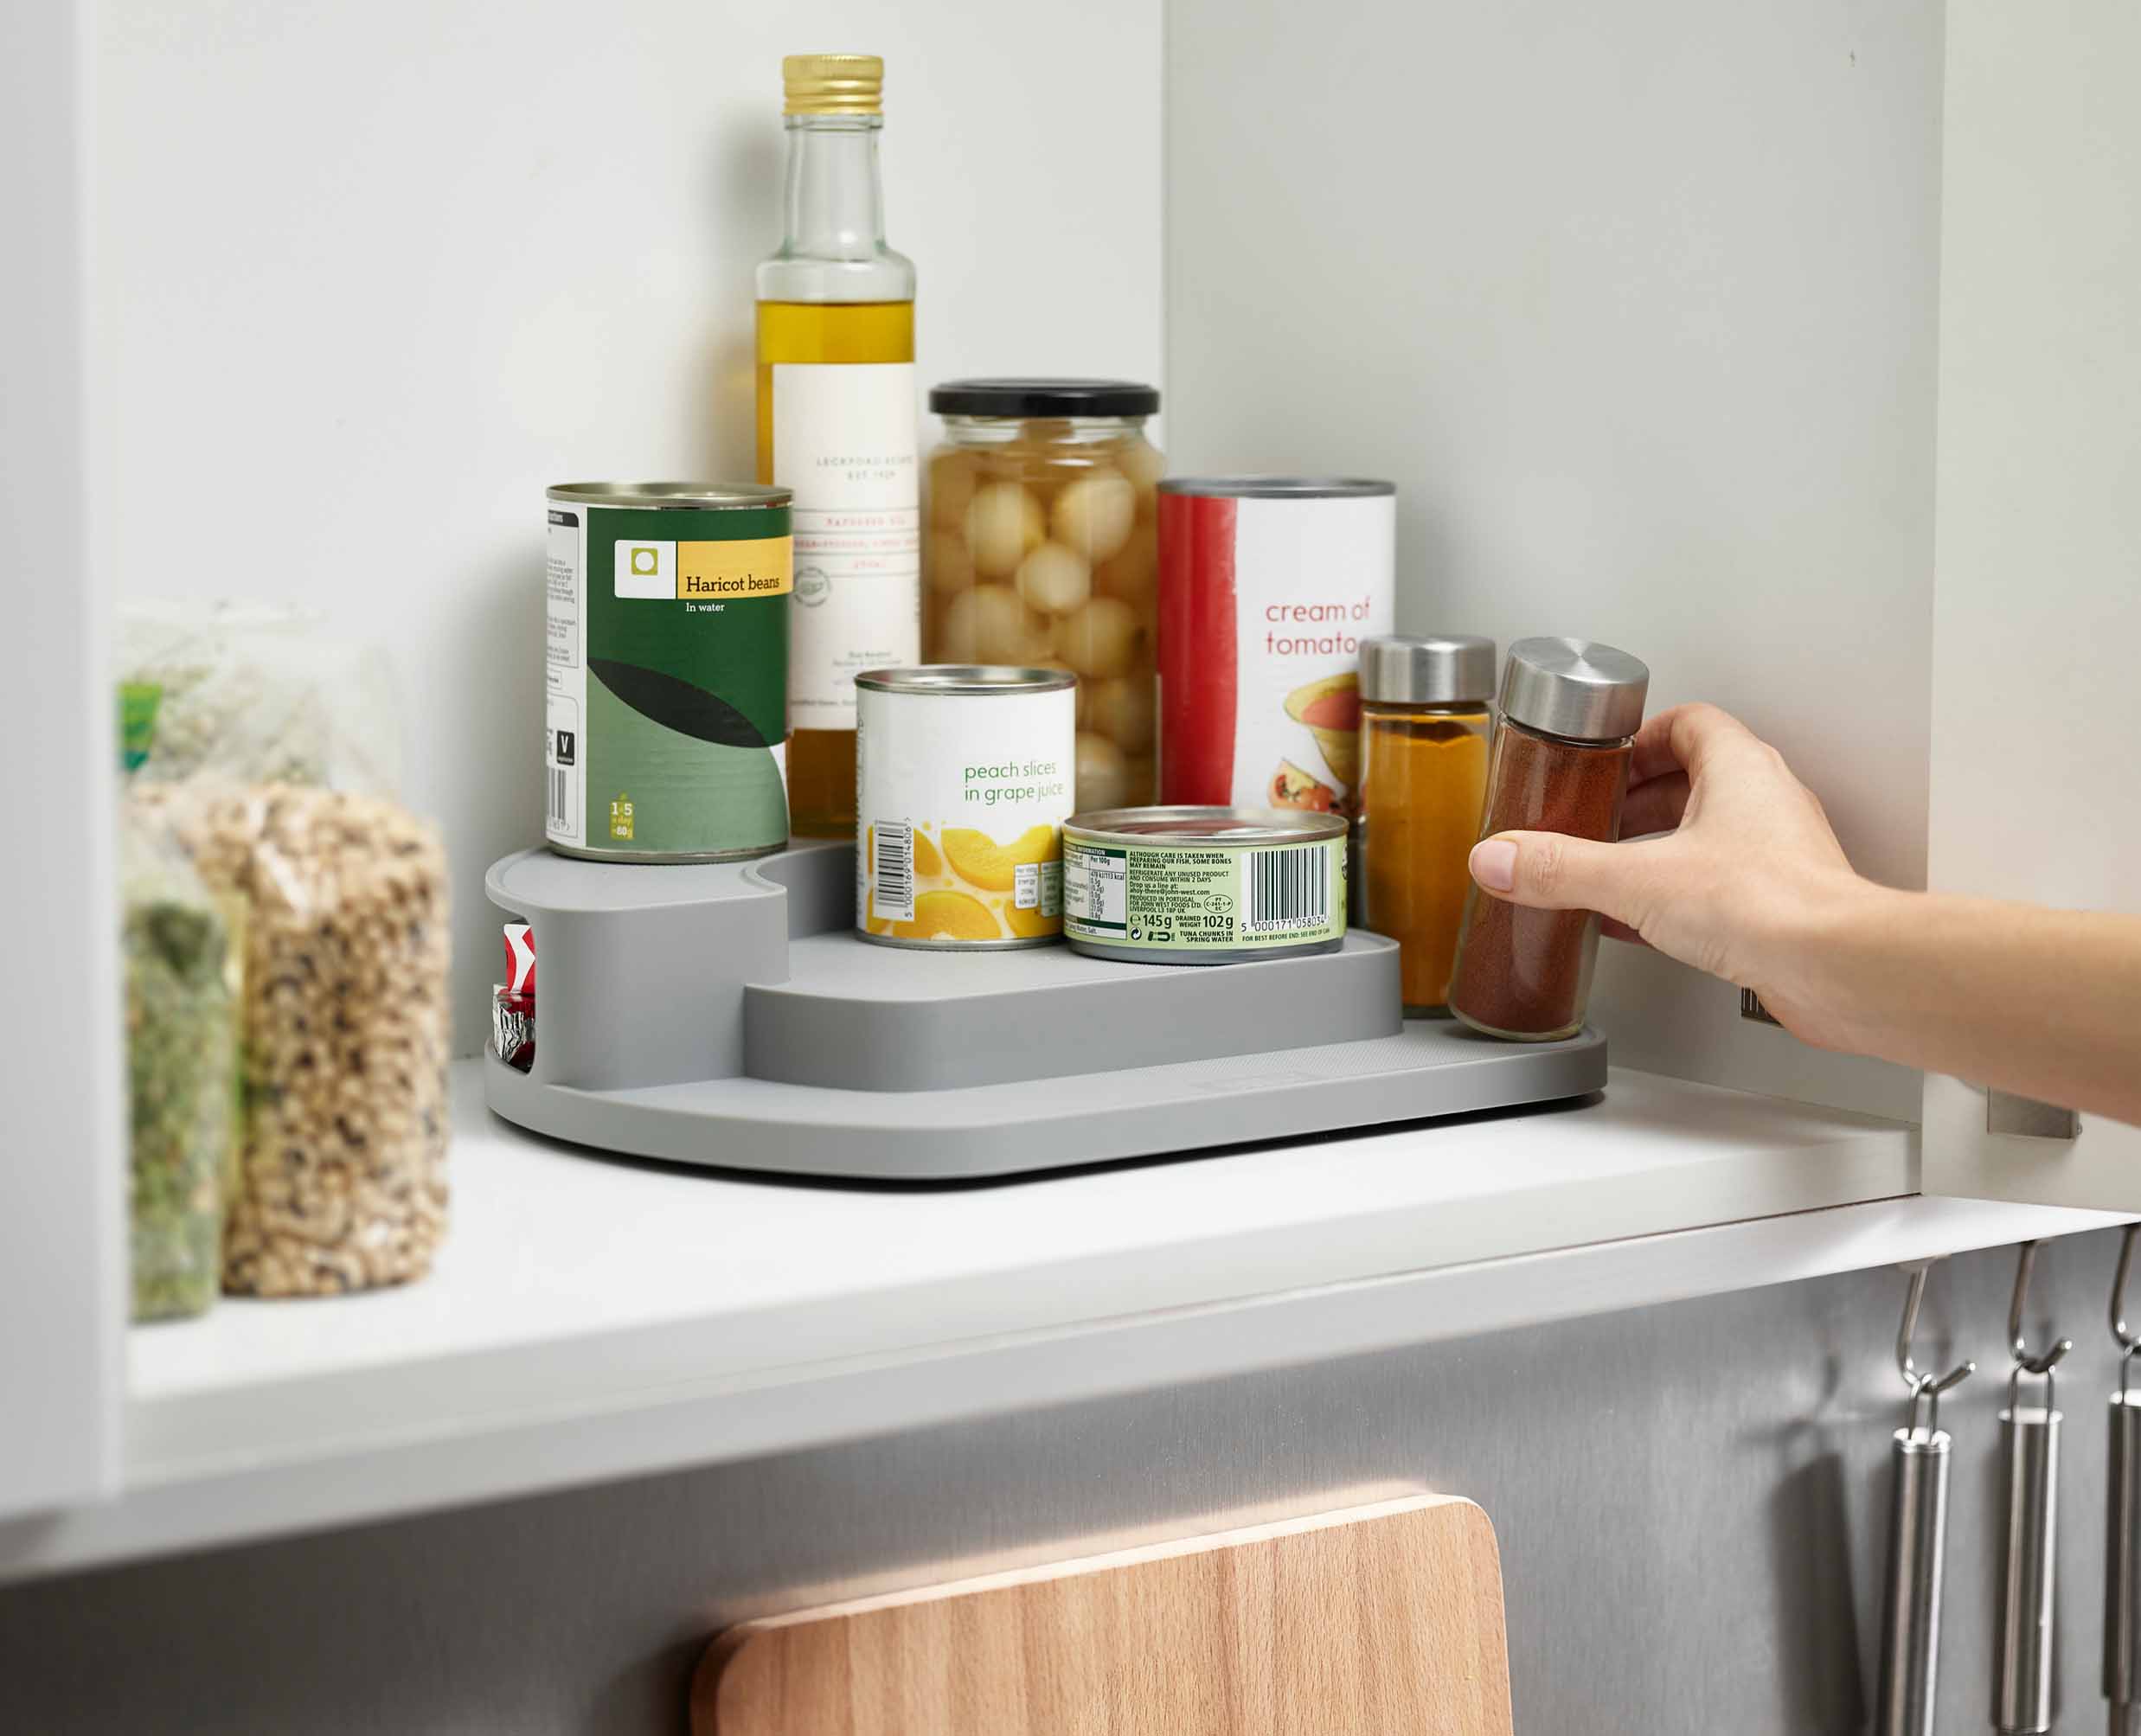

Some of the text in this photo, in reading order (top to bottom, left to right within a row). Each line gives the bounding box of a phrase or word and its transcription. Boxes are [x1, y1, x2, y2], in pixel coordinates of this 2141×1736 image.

[686, 576, 745, 593] Haricot
[747, 574, 780, 591] beans
[686, 602, 726, 612] In water
[1266, 595, 1371, 622] cream of
[1266, 631, 1357, 655] tomato
[561, 734, 568, 753] V
[965, 760, 1057, 783] peach slices
[965, 782, 1065, 805] in grape juice
[1241, 923, 1247, 932] 5
[1254, 919, 1292, 932] 000171
